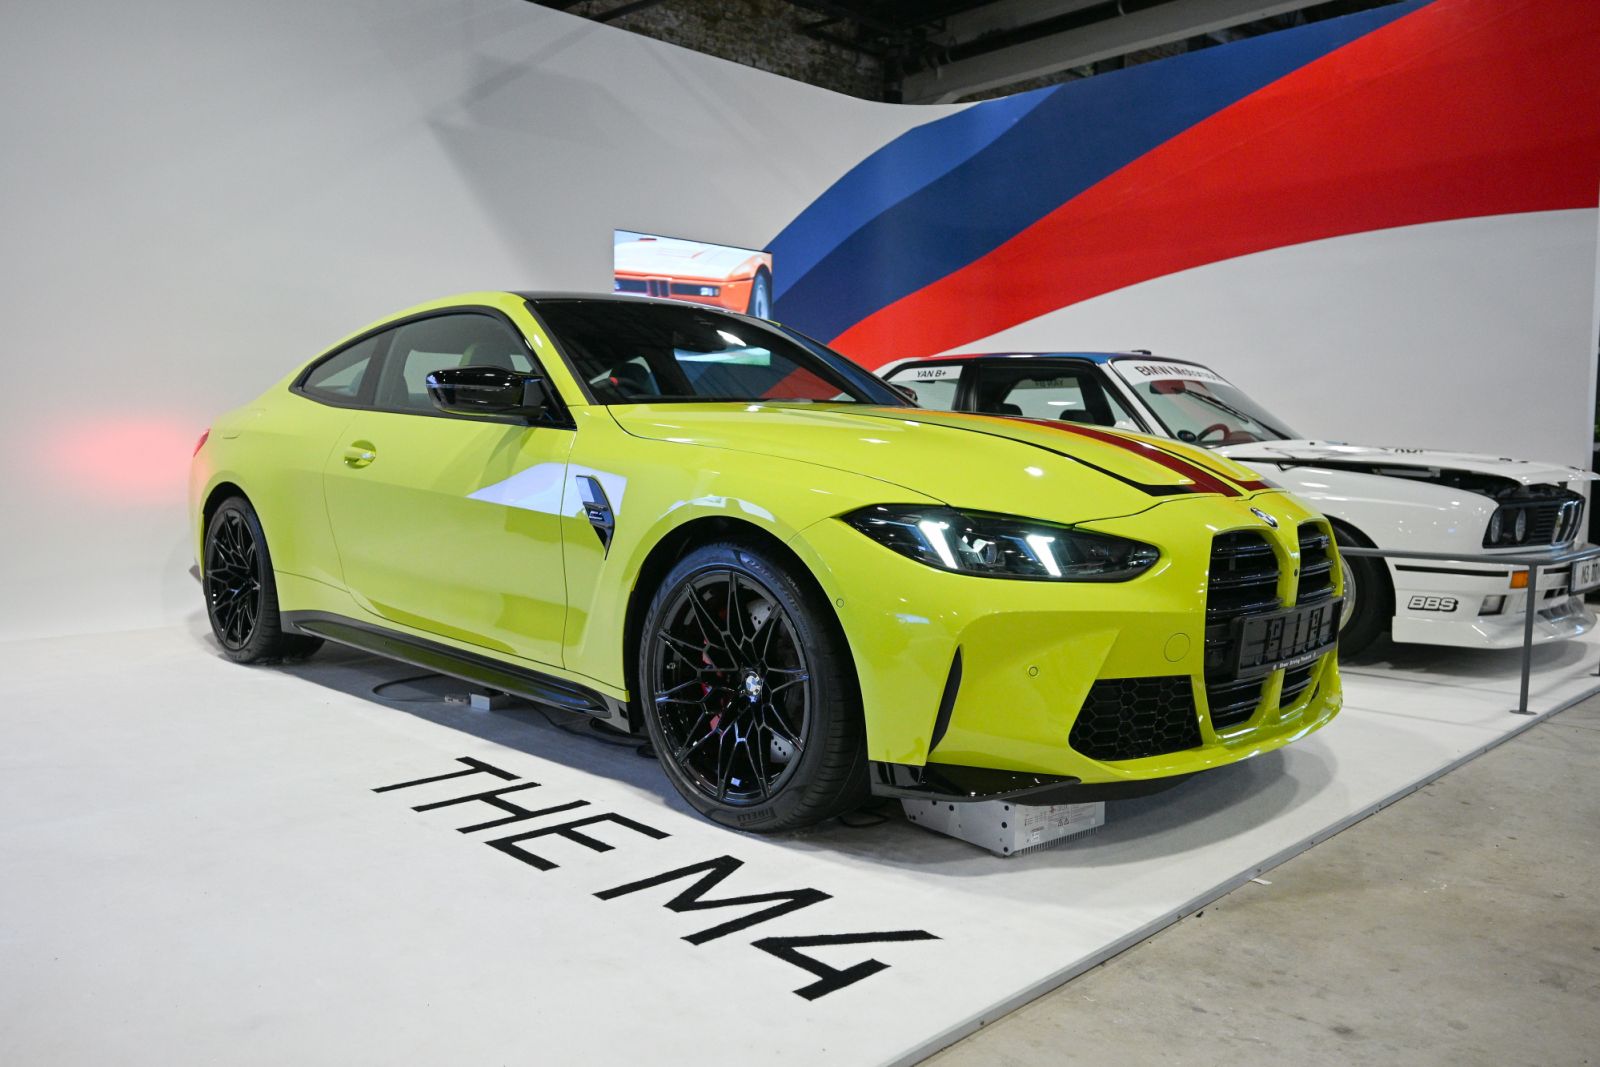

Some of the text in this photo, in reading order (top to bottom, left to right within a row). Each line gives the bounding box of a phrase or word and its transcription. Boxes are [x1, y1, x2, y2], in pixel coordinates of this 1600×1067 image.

[916, 370, 934, 378] YAN
[1134, 366, 1173, 376] BMW
[1408, 595, 1459, 612] BBS
[370, 756, 943, 1001] THE M4
